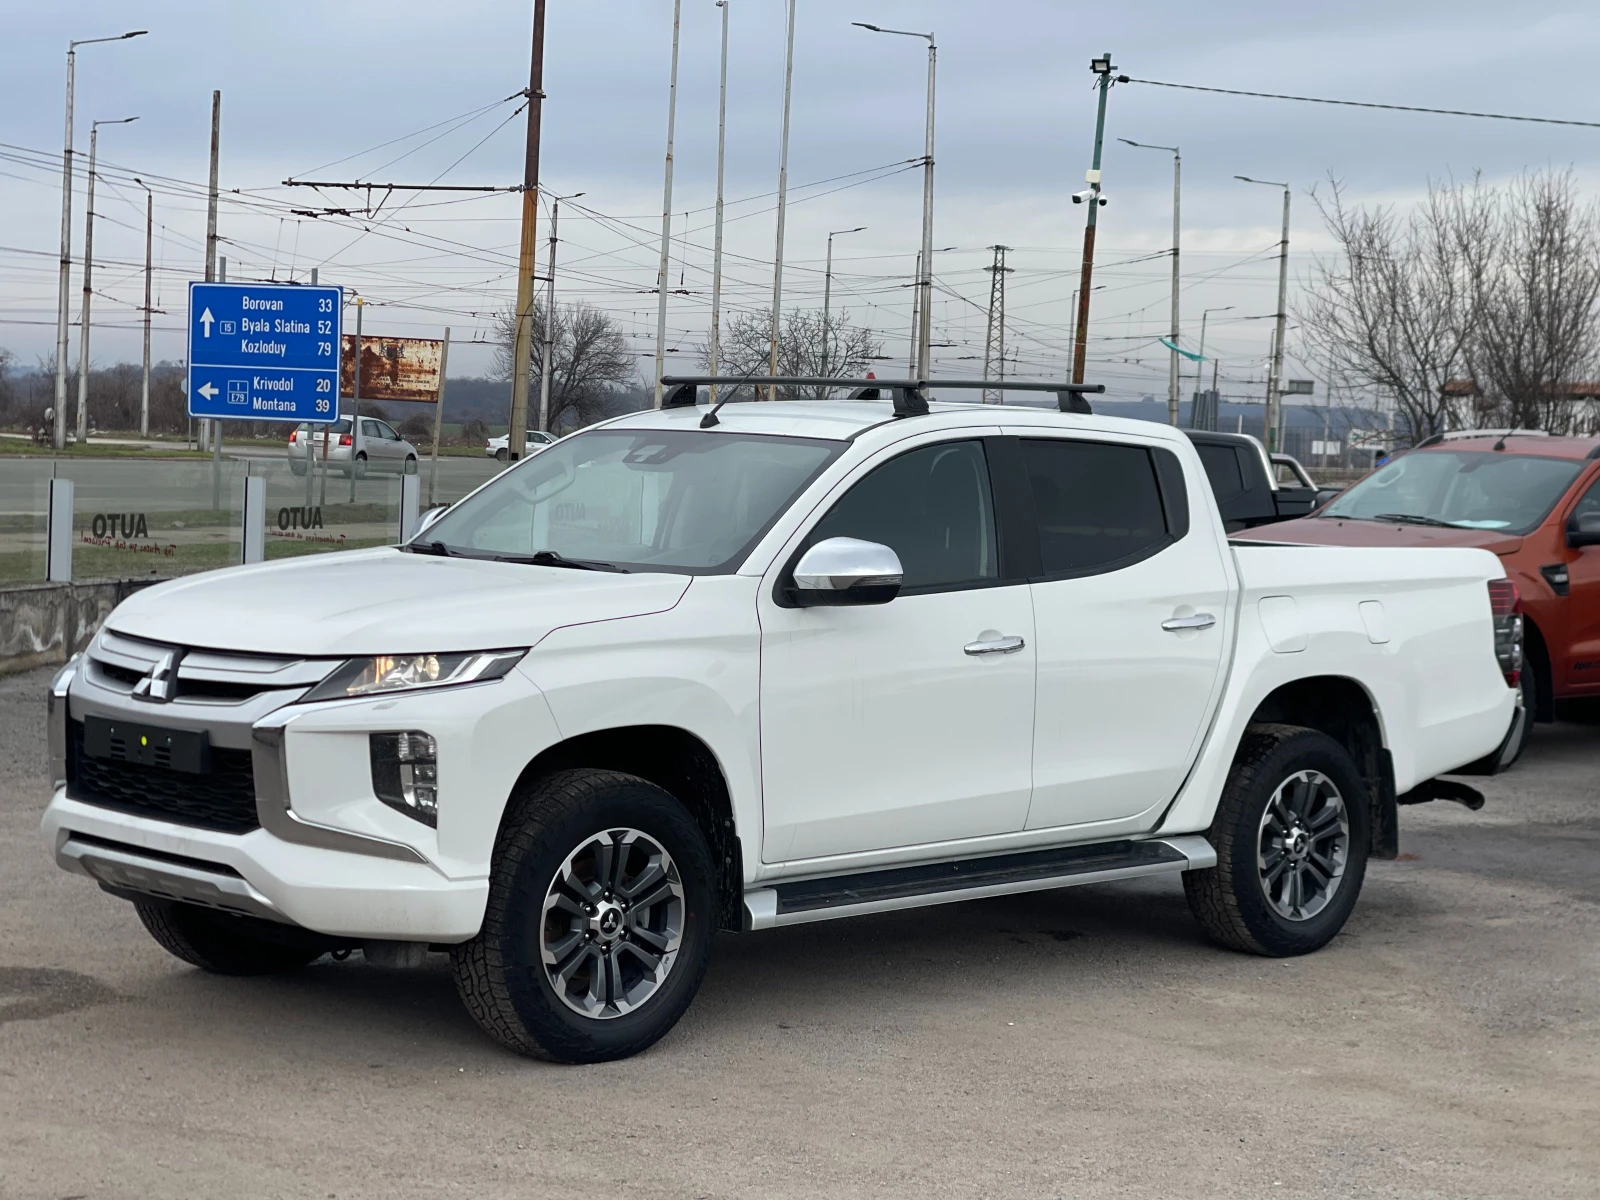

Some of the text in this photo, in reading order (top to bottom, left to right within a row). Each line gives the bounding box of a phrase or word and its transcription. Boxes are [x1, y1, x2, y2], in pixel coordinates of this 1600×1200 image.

[242, 296, 332, 312] Borovan 33
[242, 317, 332, 335] Byala Slatina 52
[241, 339, 331, 357] Kozloduy 79
[253, 376, 330, 392] Krivodol 20
[231, 393, 245, 402] E79
[253, 397, 330, 412] Montana 39
